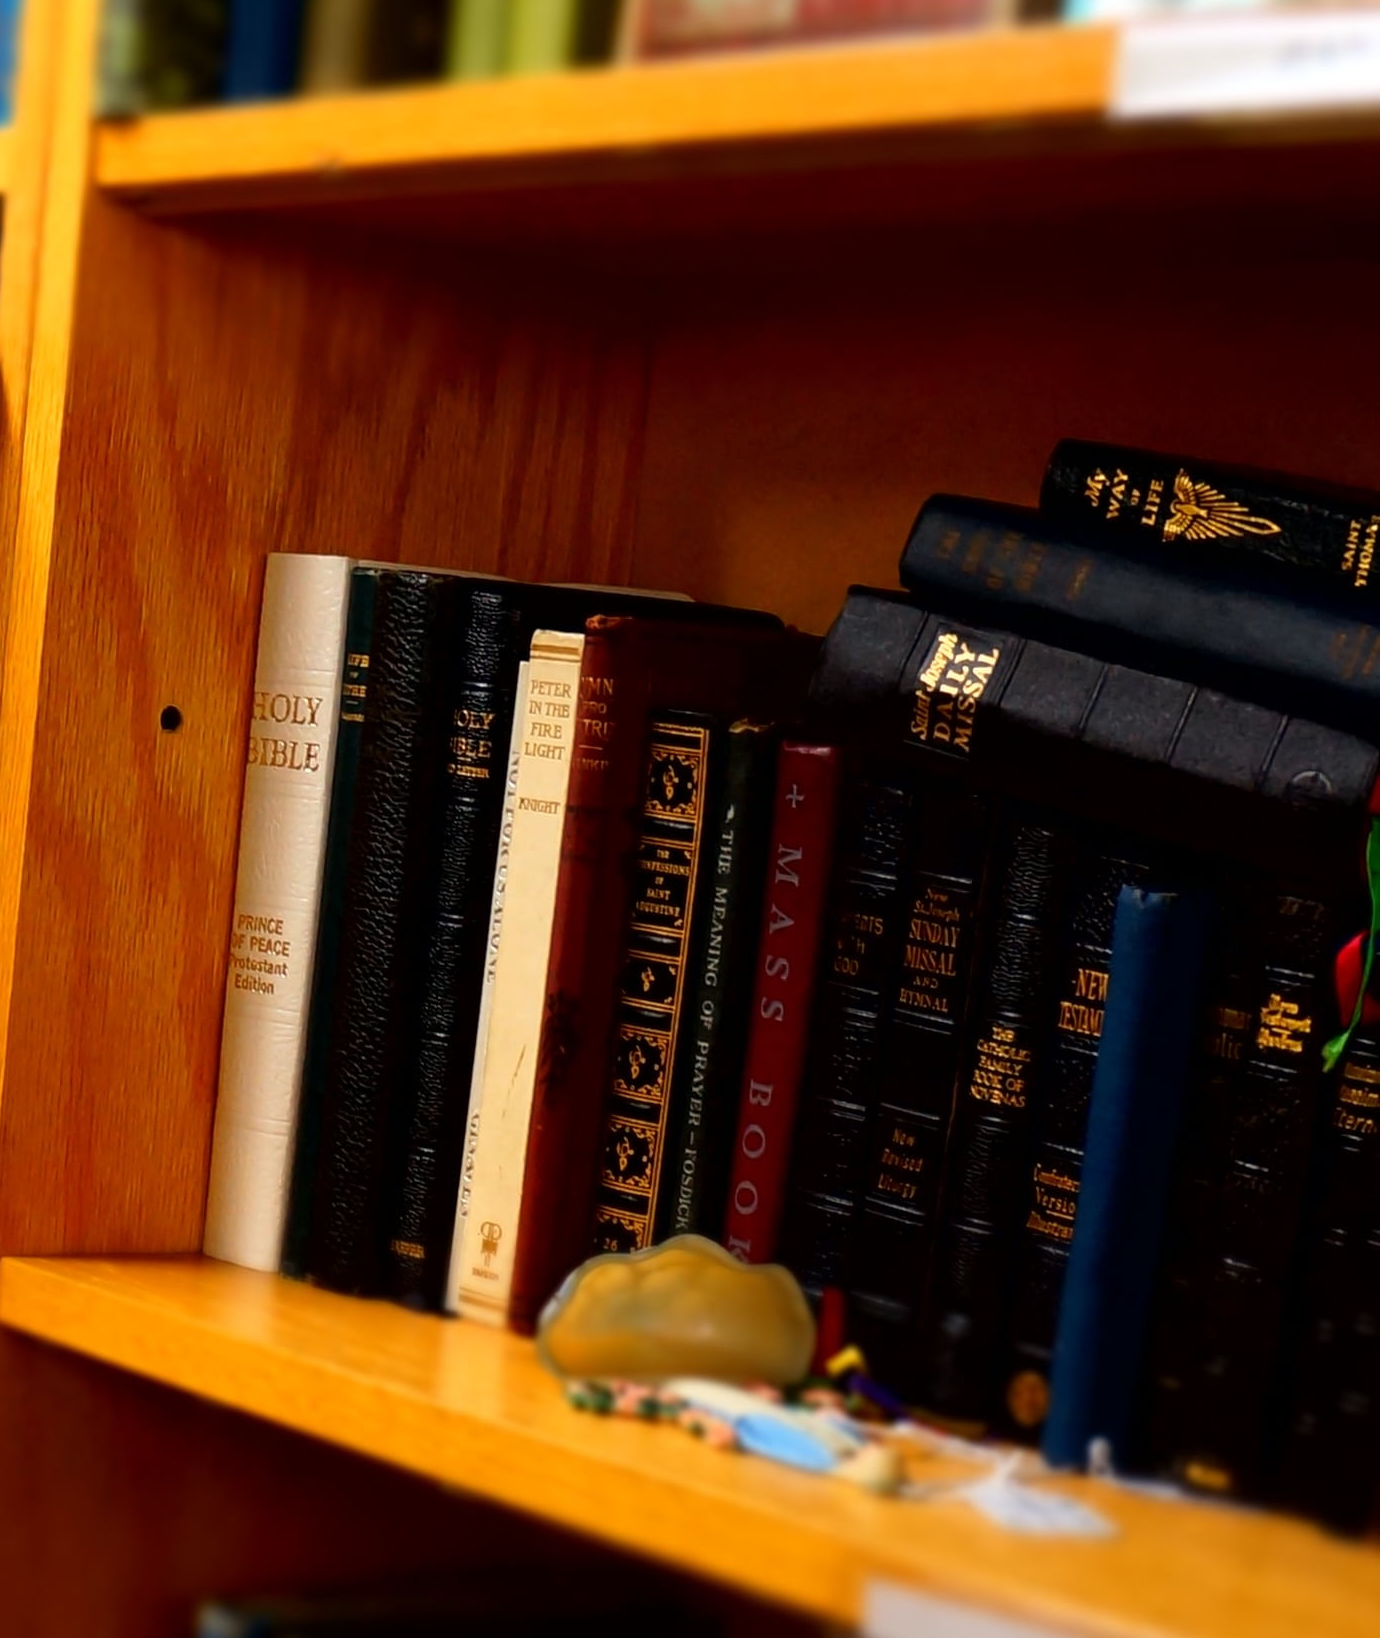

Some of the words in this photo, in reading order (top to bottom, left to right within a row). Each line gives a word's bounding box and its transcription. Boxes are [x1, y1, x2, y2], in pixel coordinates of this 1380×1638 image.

[1106, 468, 1129, 520] WAY
[1141, 479, 1165, 526] LIFE
[1341, 519, 1361, 571] SAINT
[920, 633, 958, 692] Joseph
[530, 680, 572, 699] PETER
[933, 642, 975, 742] DAILY
[953, 648, 999, 753] MISSAL
[253, 691, 324, 727] HOLY
[455, 709, 496, 730] OLY
[529, 700, 544, 715] IN
[544, 702, 571, 719] THE
[911, 689, 931, 741] Saint
[530, 722, 563, 740] FIRE
[246, 736, 321, 773] BIBLE
[524, 742, 566, 761] LIGHT
[518, 797, 561, 815] KNIGHT
[717, 830, 735, 875] THE
[639, 859, 692, 876] NFESSIONS
[646, 888, 671, 901] SAINT
[237, 914, 284, 936] PRINCE
[704, 886, 729, 987] MEANING
[760, 843, 803, 1022] MASS
[909, 918, 962, 949] SUNDAY
[231, 934, 247, 951] OF
[250, 936, 291, 957] PEACE
[227, 952, 288, 978] Protestant
[903, 944, 957, 977] MISSAL
[234, 973, 275, 995] Edition
[912, 976, 940, 990] AND
[899, 988, 950, 1013] HYMNAL
[700, 1000, 717, 1030] OF
[1058, 1001, 1106, 1037] TESTAM
[992, 1026, 1016, 1043] THE
[976, 1039, 1033, 1062] CATHOLIC
[978, 1055, 1024, 1076] FAMILY
[688, 1040, 710, 1126] PRAYER
[972, 1069, 1004, 1090] BOOK
[1005, 1077, 1026, 1093] OF
[970, 1084, 1027, 1109] NOVENAS
[892, 1128, 917, 1147] New
[727, 1078, 774, 1263] BOOK
[675, 1147, 698, 1230] FOSDICK
[1034, 1186, 1077, 1213] Versio
